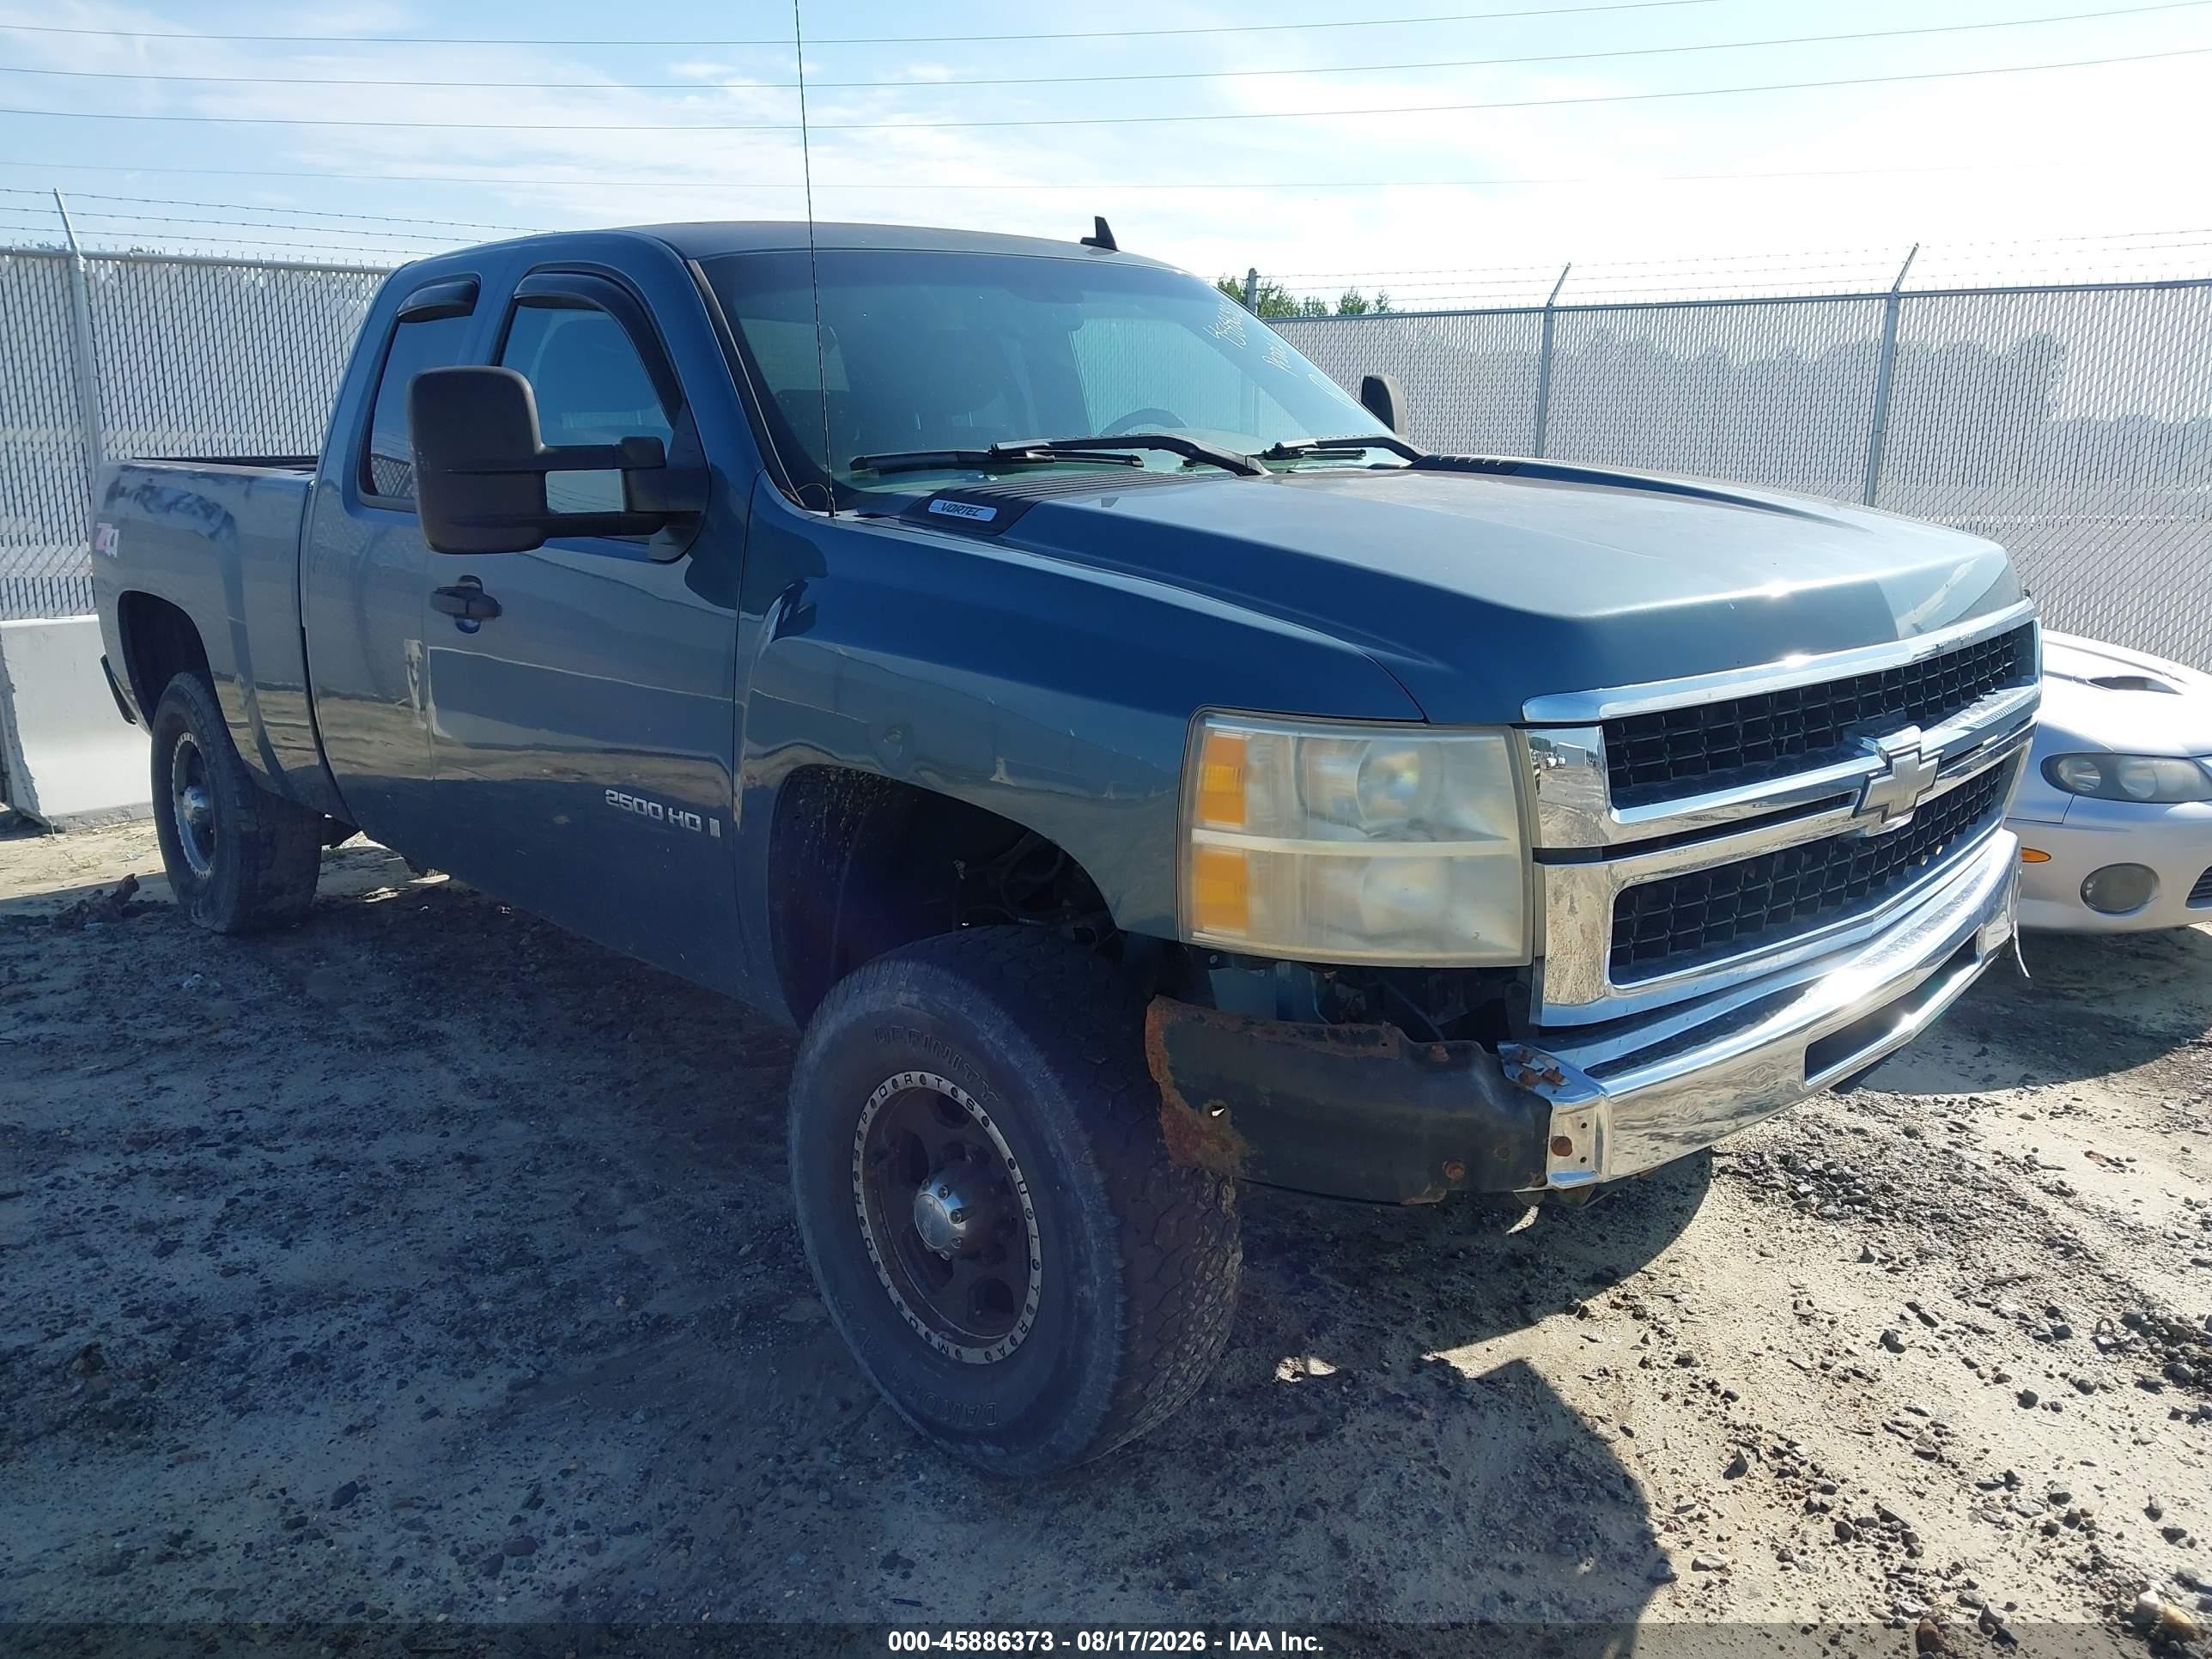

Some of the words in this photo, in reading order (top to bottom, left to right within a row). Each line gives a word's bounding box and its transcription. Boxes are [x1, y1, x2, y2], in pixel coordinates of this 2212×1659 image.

[941, 502, 985, 517] VORTEC
[605, 788, 664, 821] 2500
[668, 806, 702, 832] HD
[872, 1024, 1000, 1103] DEFINITY
